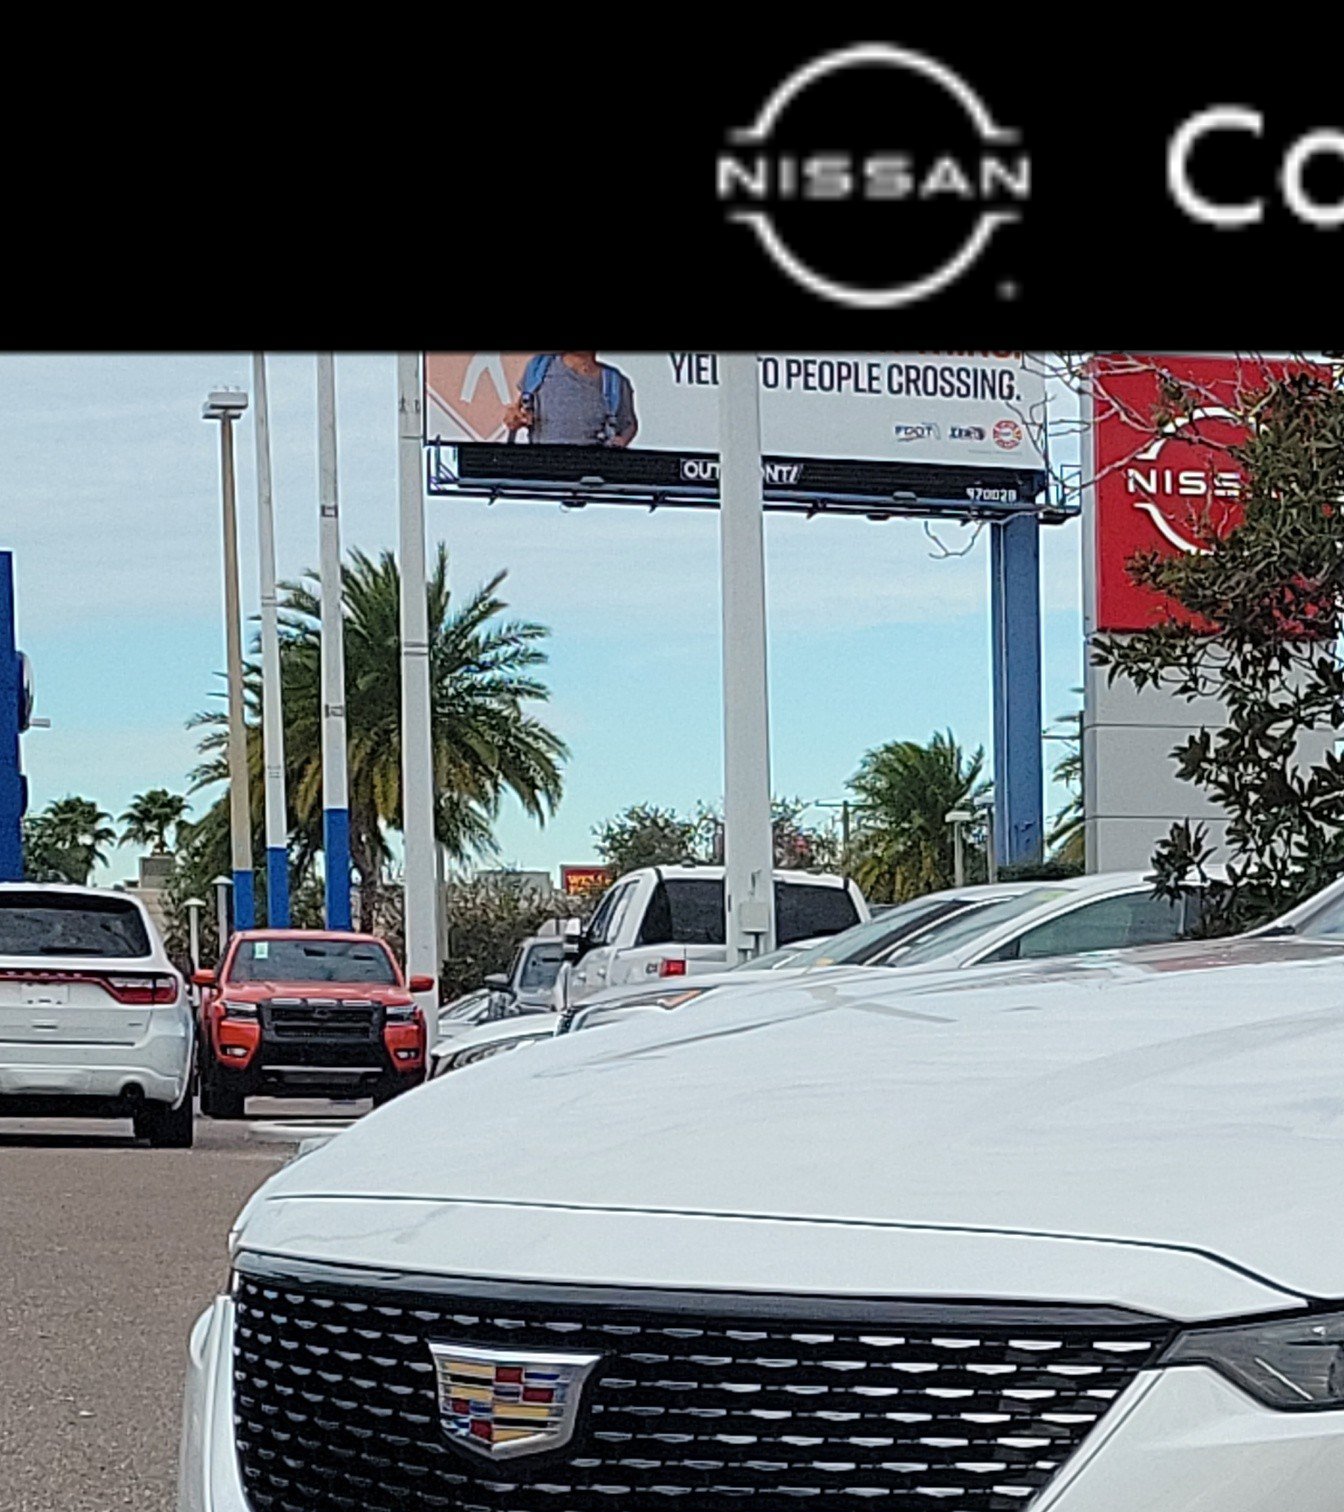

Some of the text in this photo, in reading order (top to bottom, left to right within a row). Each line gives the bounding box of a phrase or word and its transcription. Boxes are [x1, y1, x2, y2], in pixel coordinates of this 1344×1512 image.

[669, 352, 719, 386] YIEL
[785, 359, 882, 395] PEOPLE
[886, 363, 1022, 402] CROSSING.
[1127, 468, 1242, 497] NISS
